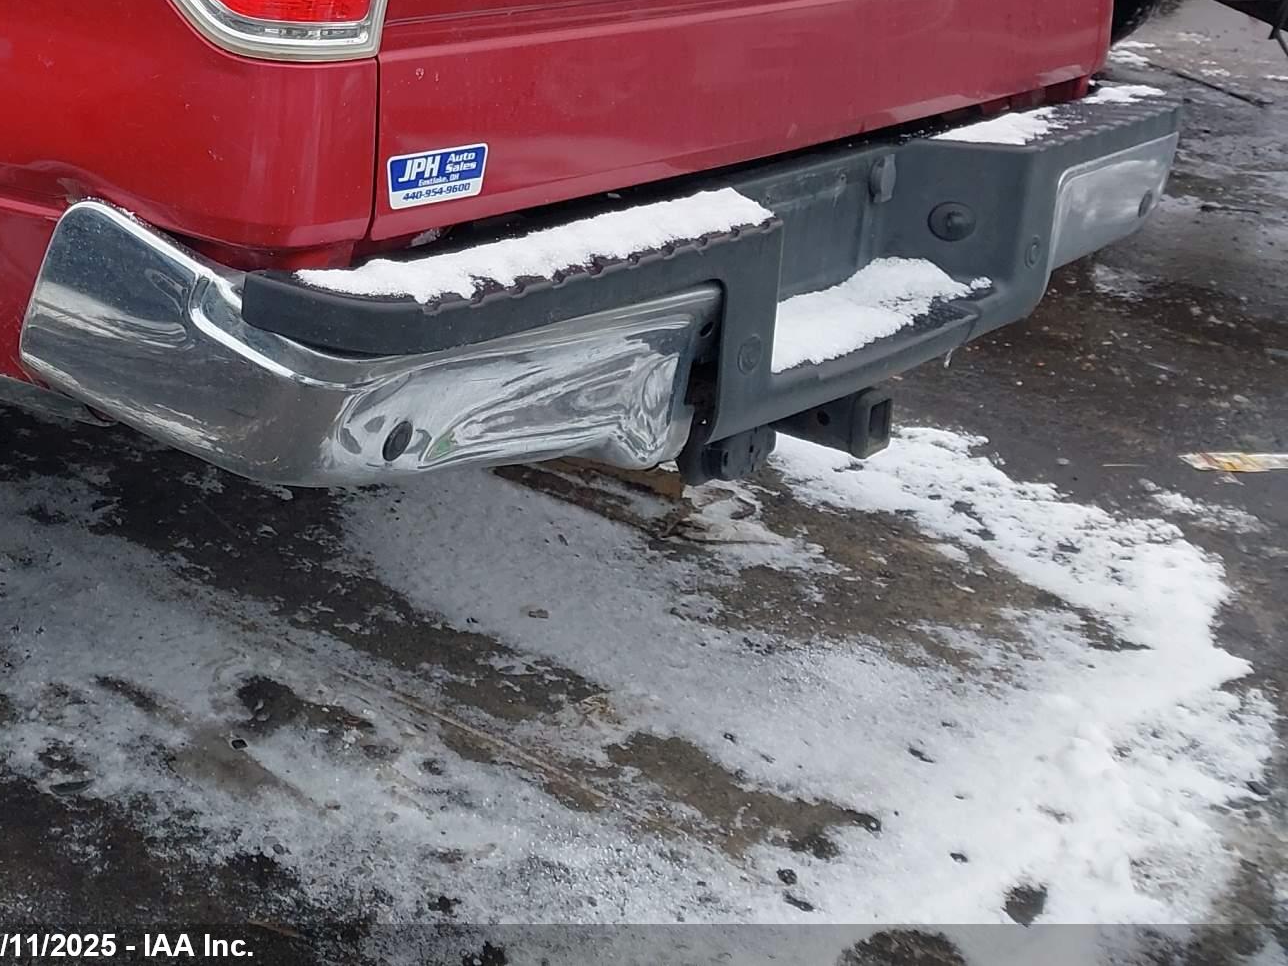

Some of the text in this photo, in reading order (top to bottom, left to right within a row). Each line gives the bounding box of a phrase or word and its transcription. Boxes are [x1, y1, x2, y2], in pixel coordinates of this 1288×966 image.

[447, 152, 476, 163] Auto
[398, 155, 441, 183] JPH
[445, 161, 477, 174] Sales
[402, 183, 471, 201] 440-954-9600
